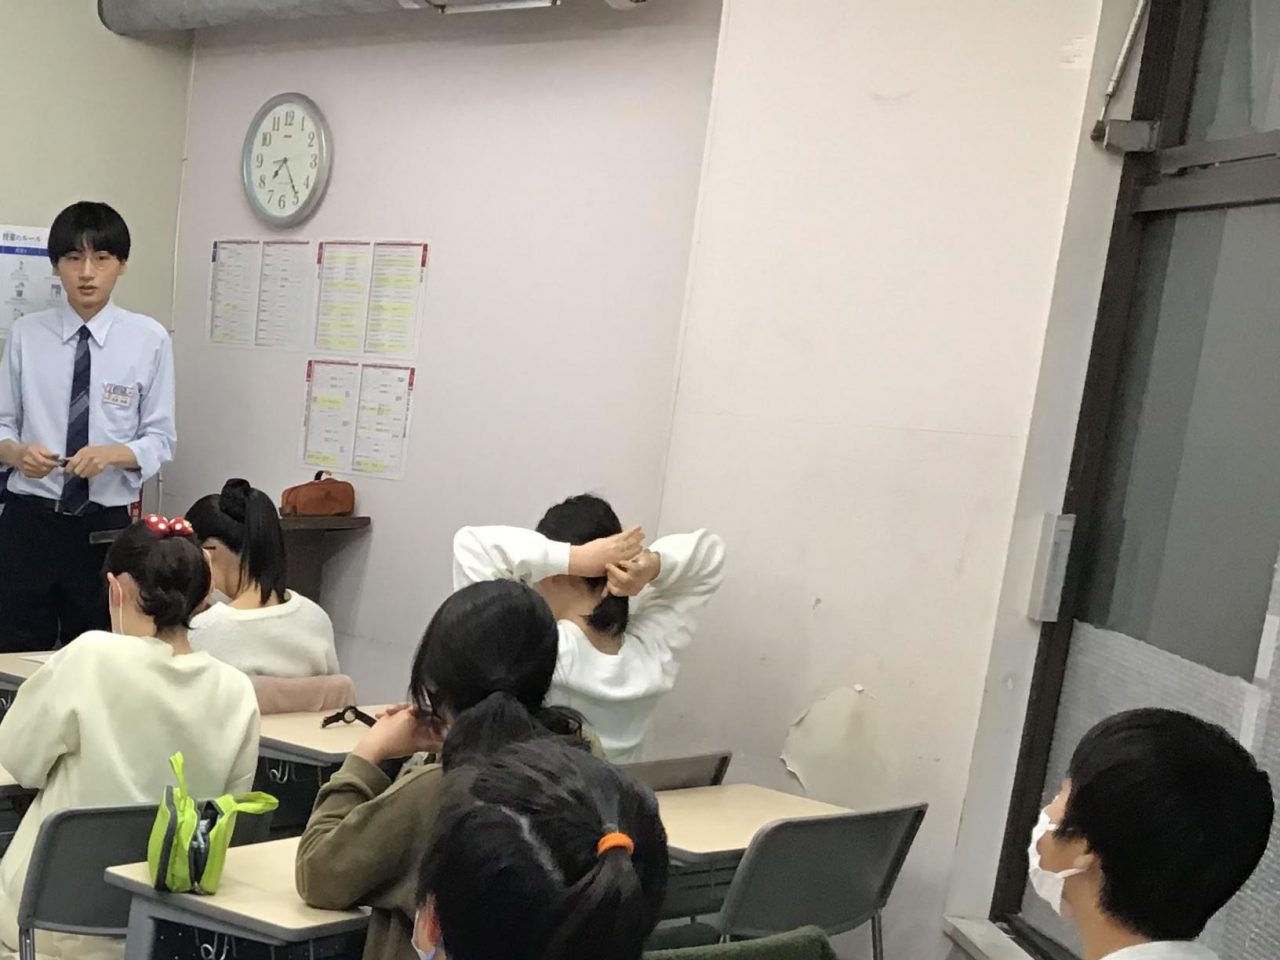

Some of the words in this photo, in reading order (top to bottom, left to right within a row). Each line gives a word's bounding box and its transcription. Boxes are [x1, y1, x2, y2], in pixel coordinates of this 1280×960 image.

[272, 116, 281, 132] 11
[284, 110, 295, 127] 12
[261, 131, 272, 147] 10
[307, 132, 315, 147] 2
[256, 153, 264, 168] 9
[309, 153, 318, 169] 3
[259, 174, 266, 189] 8
[303, 175, 310, 190] 4
[267, 189, 275, 204] 7
[278, 194, 286, 210] 6
